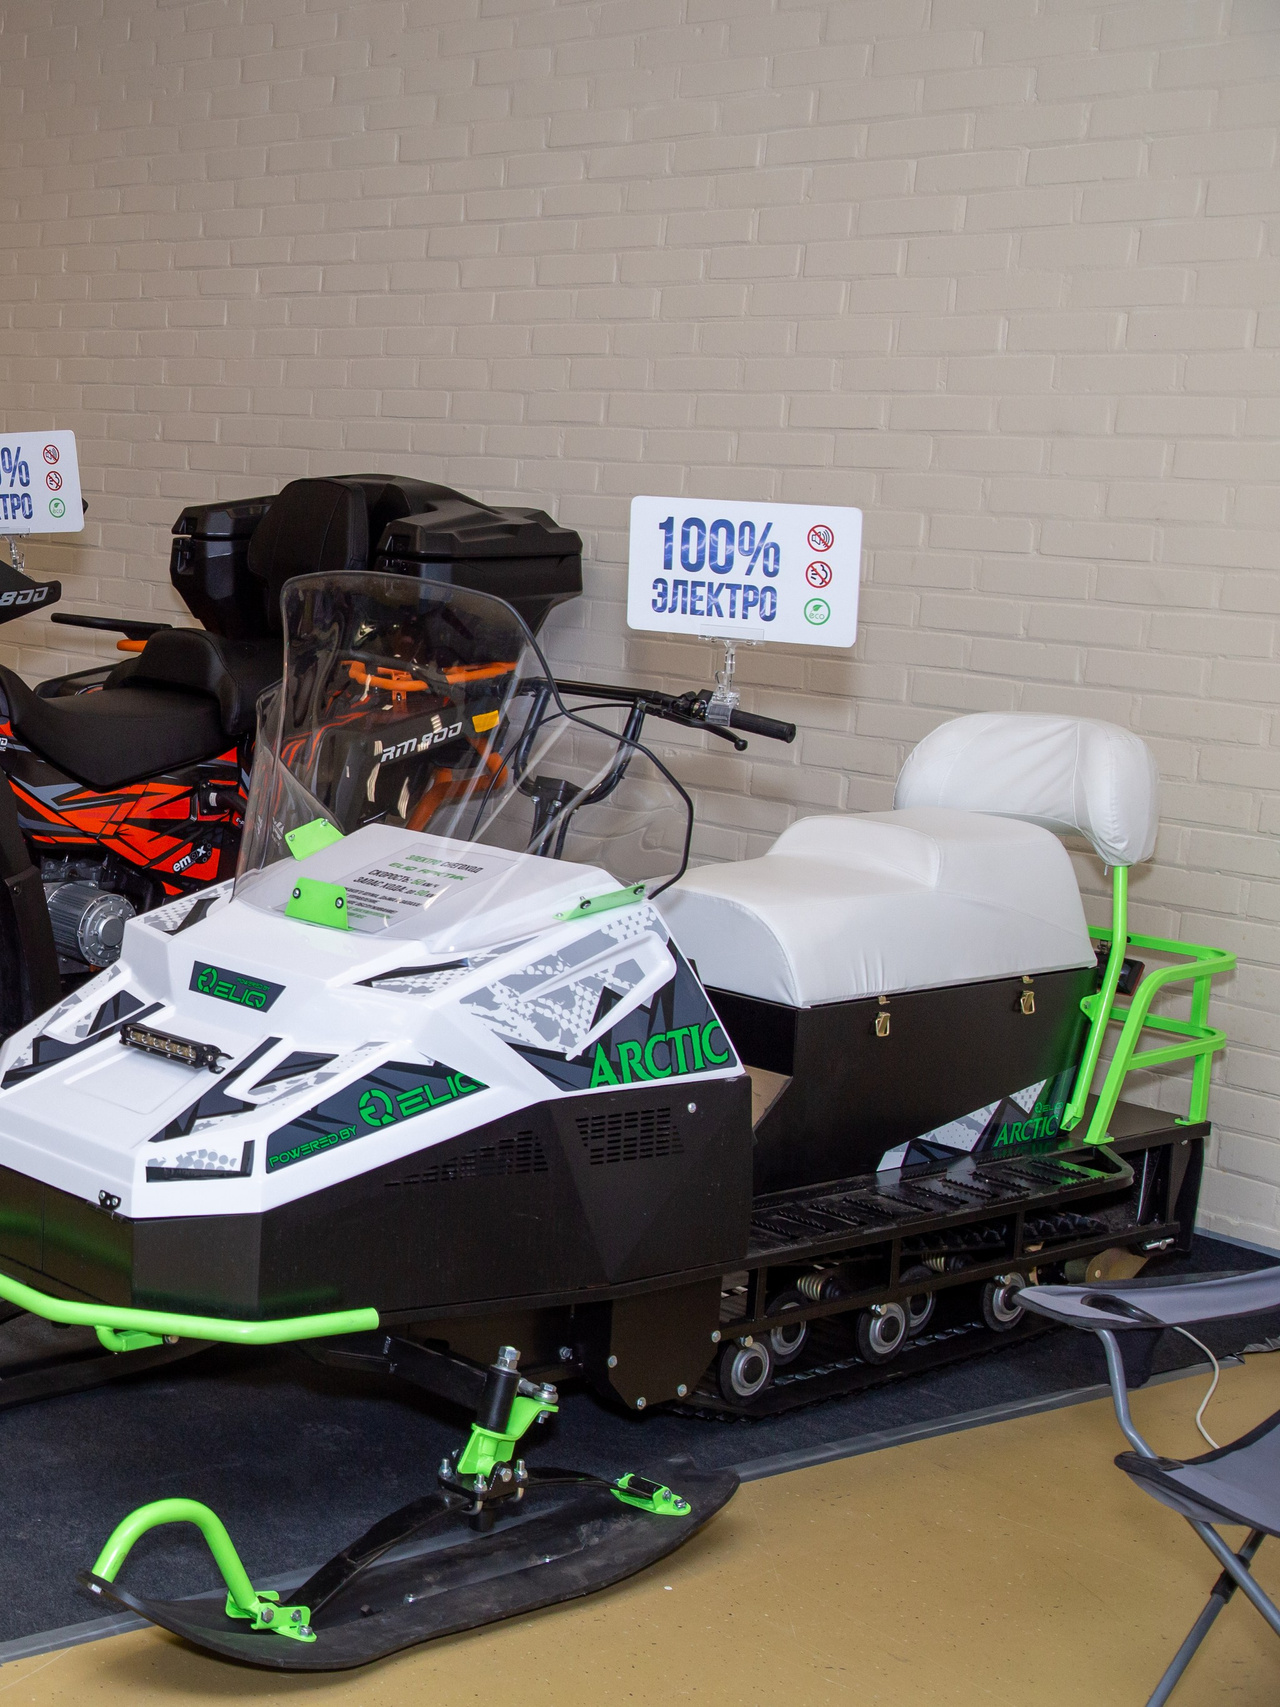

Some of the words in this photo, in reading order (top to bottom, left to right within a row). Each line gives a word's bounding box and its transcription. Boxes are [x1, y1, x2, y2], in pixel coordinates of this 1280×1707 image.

[659, 516, 781, 578] 100%
[651, 577, 778, 622] ЭЛЕКТРО
[809, 611, 825, 620] eco
[380, 737, 418, 763] RM
[172, 845, 207, 873] emax
[405, 854, 442, 866] ЭЛЕКТРО
[440, 861, 484, 874] СНЕГОХОД
[353, 876, 383, 888] ЗАПАС
[381, 883, 410, 893] ХОДА:
[368, 869, 412, 884] СКОРОСТЬ:
[213, 980, 267, 1008] ELIQ
[589, 1019, 729, 1089] ARCTIC
[993, 1114, 1059, 1148] ARCTIC
[268, 1132, 339, 1168] POWERED
[338, 1124, 358, 1141] BY
